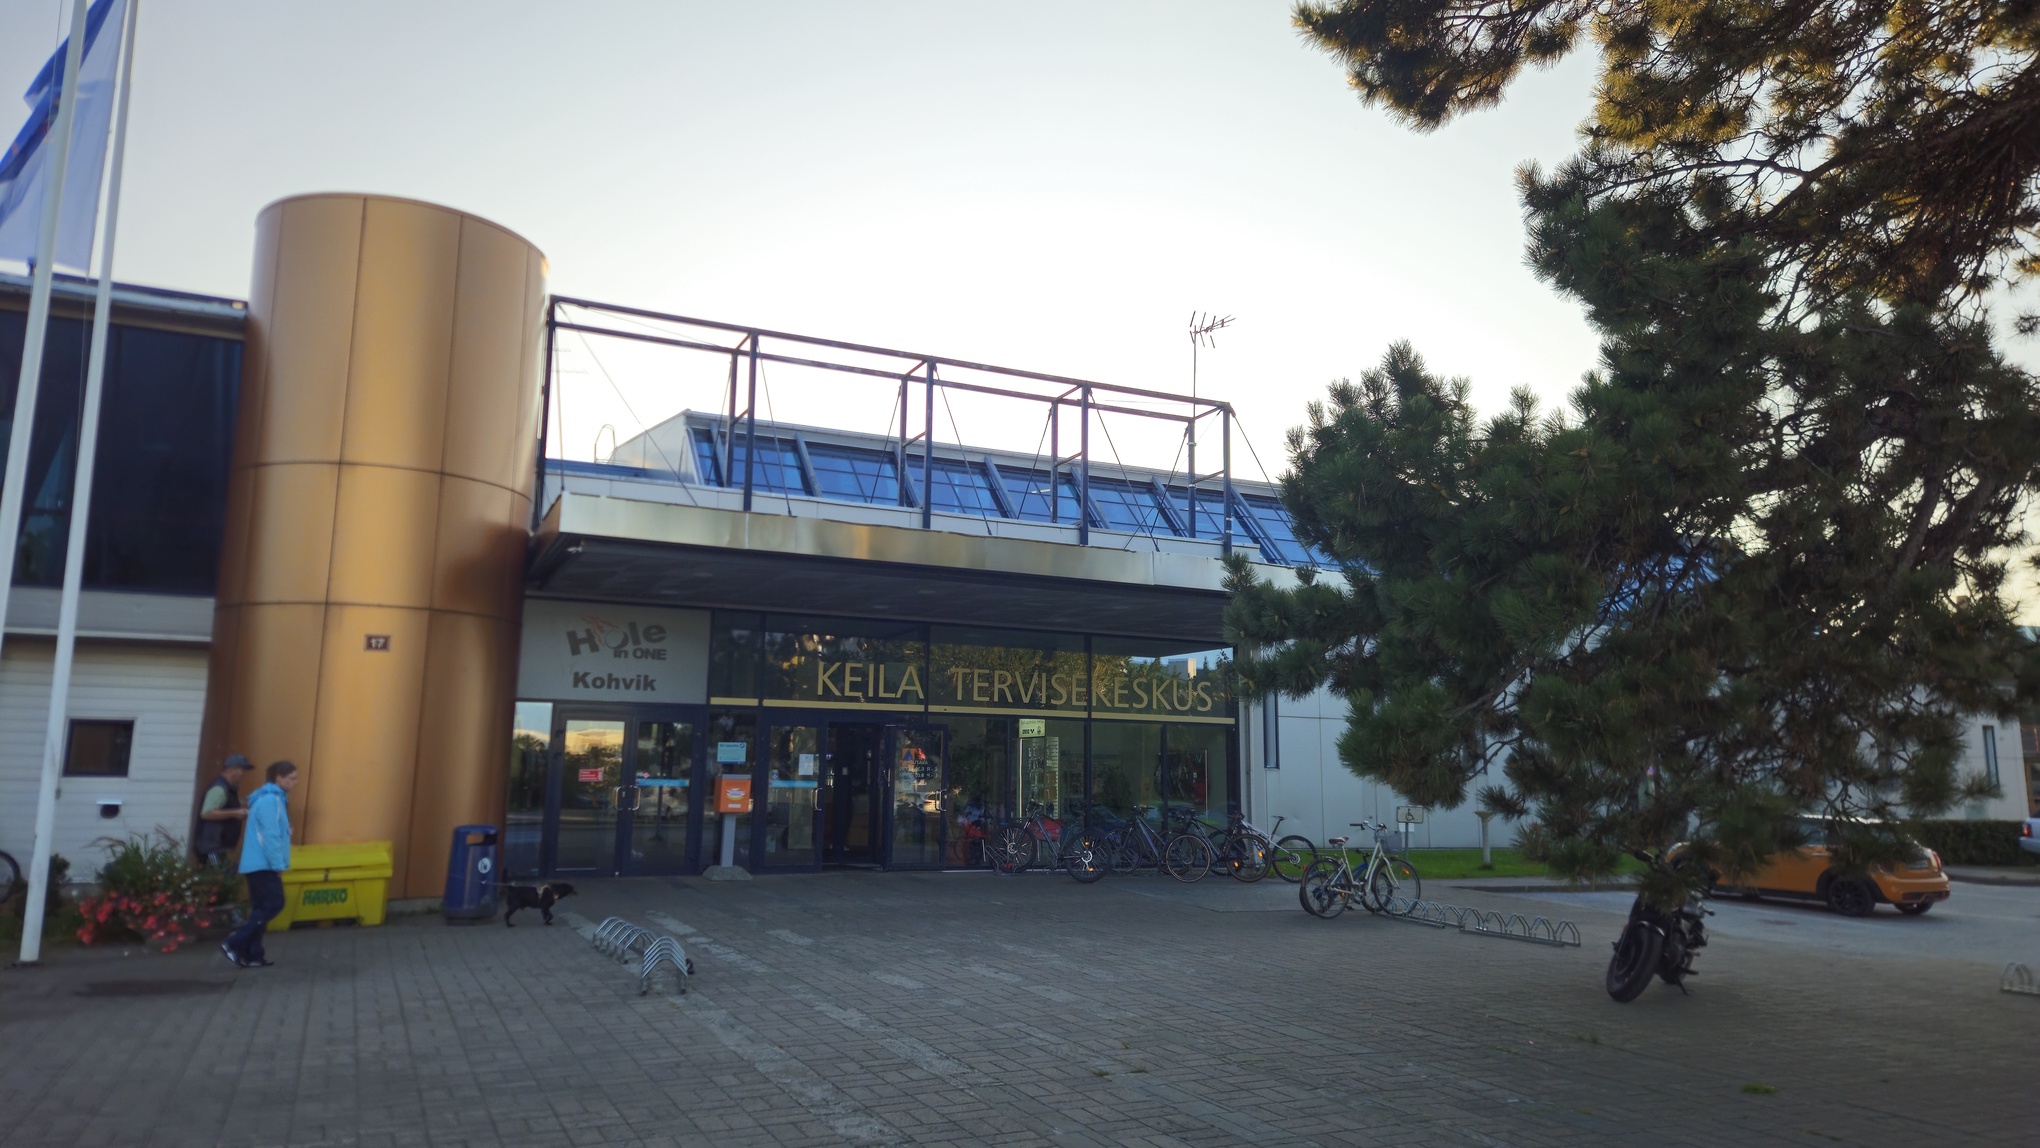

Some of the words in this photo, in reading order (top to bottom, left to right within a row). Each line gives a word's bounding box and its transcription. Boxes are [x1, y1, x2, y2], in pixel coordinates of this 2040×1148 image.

[370, 638, 386, 649] 17
[566, 622, 667, 656] Hole
[632, 648, 667, 660] ONE
[573, 671, 657, 691] Kohvik
[817, 661, 925, 699] KEILA
[950, 667, 1213, 712] TERVISEKESKUS
